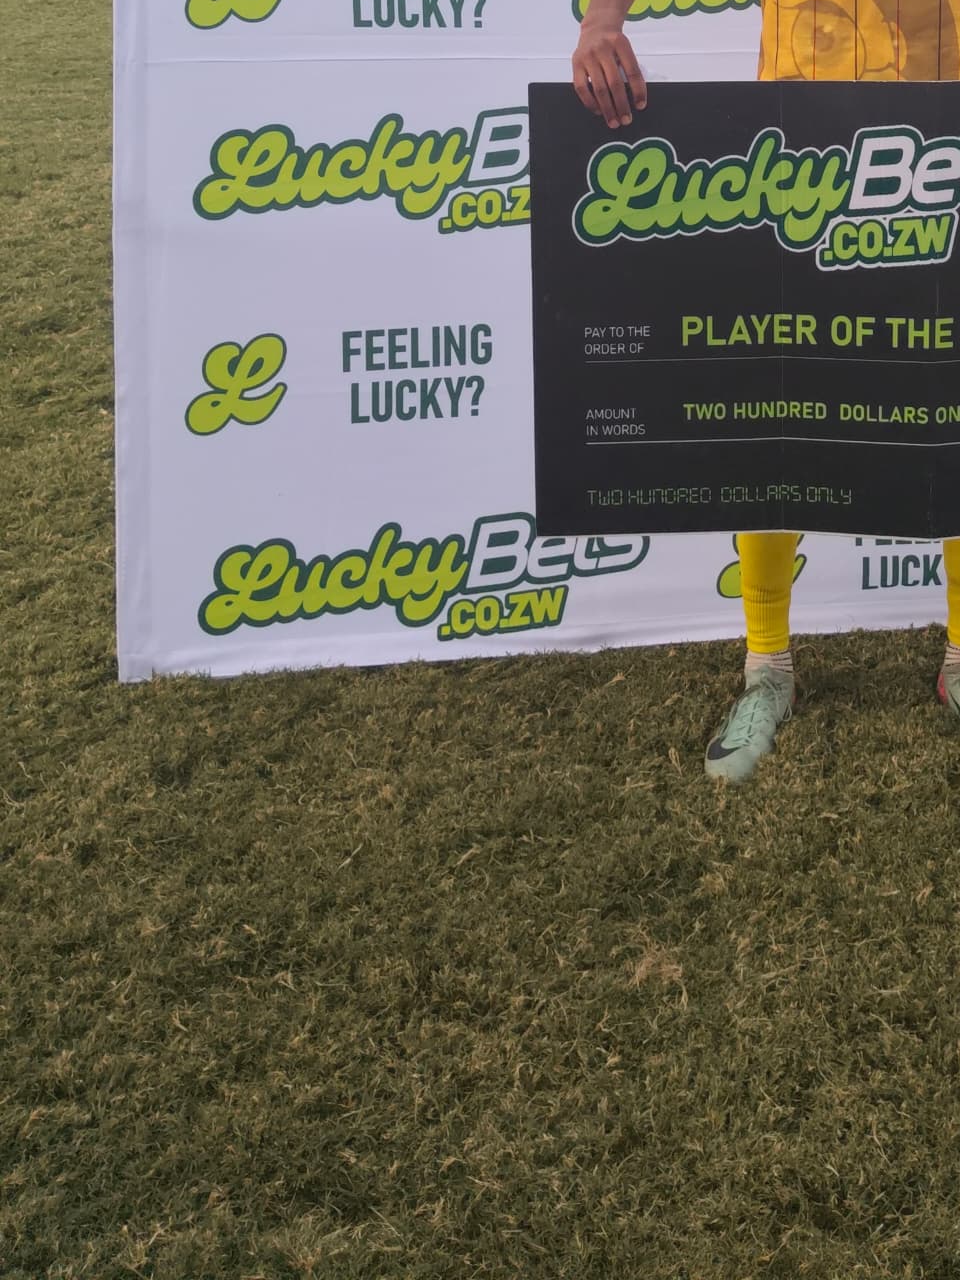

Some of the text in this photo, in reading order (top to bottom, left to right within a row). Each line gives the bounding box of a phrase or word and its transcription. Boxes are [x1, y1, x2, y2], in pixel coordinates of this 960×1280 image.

[193, 106, 529, 220] LuckyB
[438, 185, 531, 233] .CO.Z
[818, 210, 959, 270] .CO.ZW
[341, 323, 492, 372] FEELING
[584, 325, 651, 339] PAY TO THE
[584, 342, 645, 355] ORDER OF
[681, 313, 818, 347] PLAYER
[830, 315, 876, 347] OF
[885, 317, 954, 349] THE
[350, 375, 486, 424] LUCKY?
[585, 407, 637, 421] AMOUNT
[682, 402, 727, 421] TWO
[733, 400, 828, 420] HUNDRED
[839, 403, 929, 425] DOLLARS
[586, 423, 646, 437] IN WORDS
[587, 484, 852, 506] TWO HUNDRED DOLLARS ONLY
[862, 554, 942, 590] LUCK
[438, 584, 568, 640] .CO.ZW
